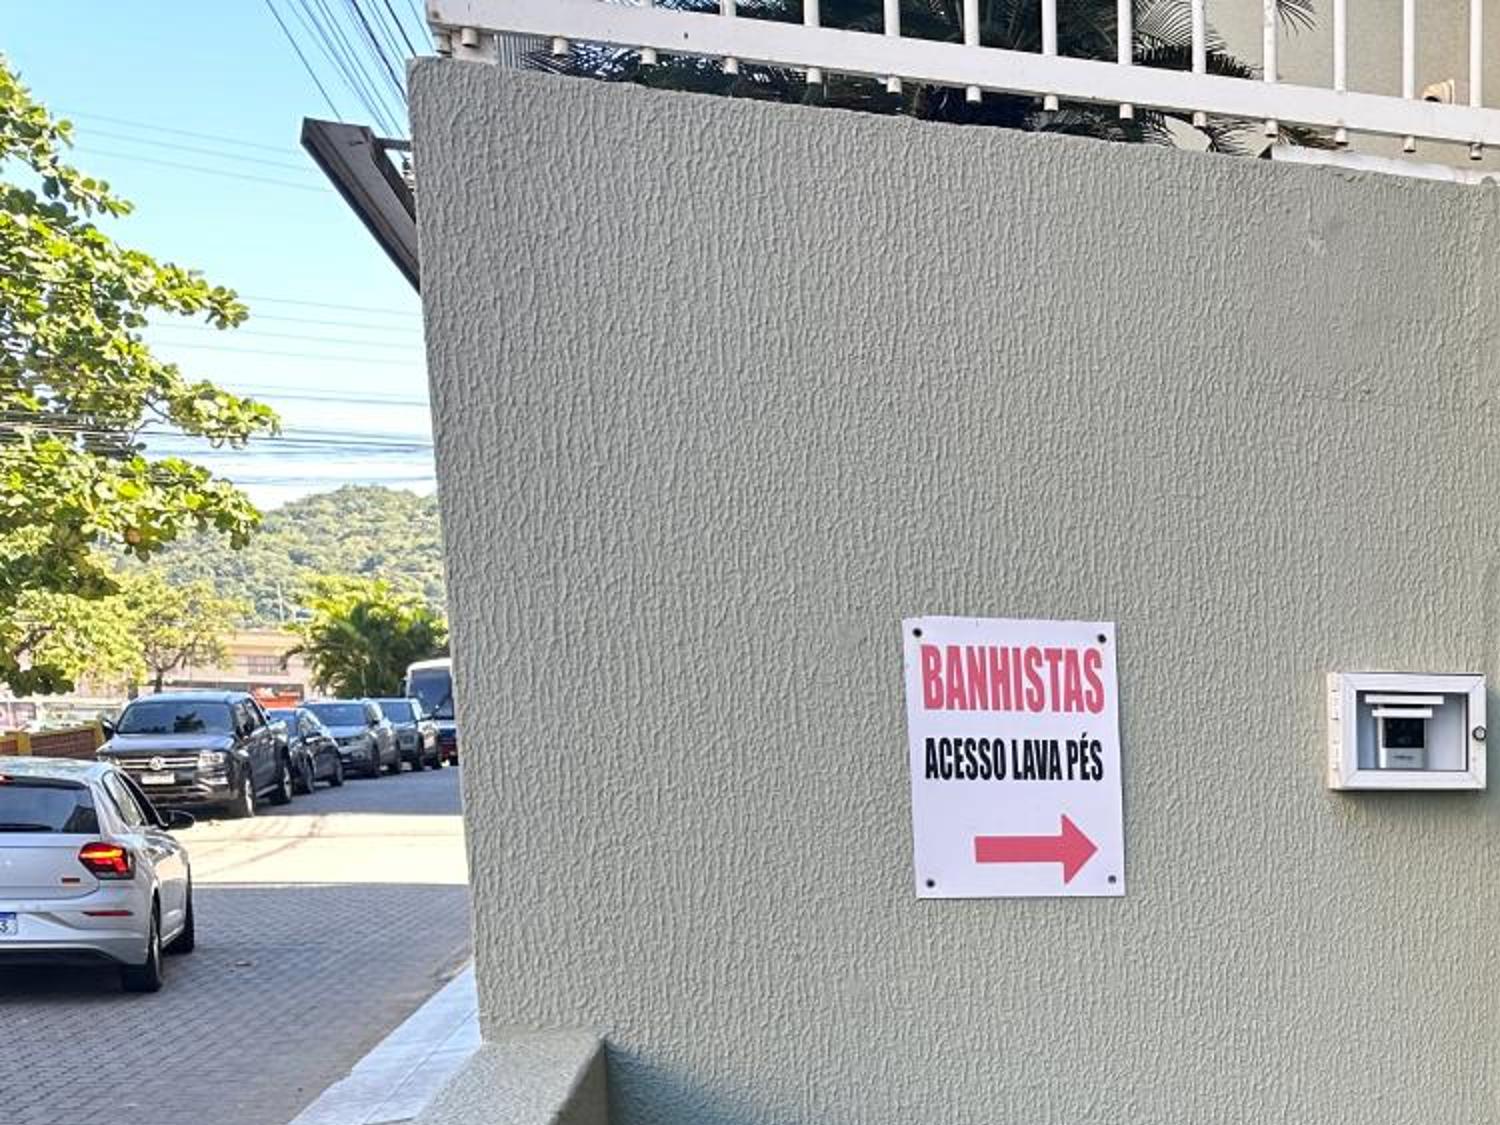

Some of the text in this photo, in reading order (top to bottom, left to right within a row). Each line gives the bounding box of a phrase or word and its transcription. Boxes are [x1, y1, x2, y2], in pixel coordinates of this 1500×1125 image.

[920, 644, 1105, 714] BANHISTAS
[925, 732, 1103, 780] ACESSO LAVA PÉS
